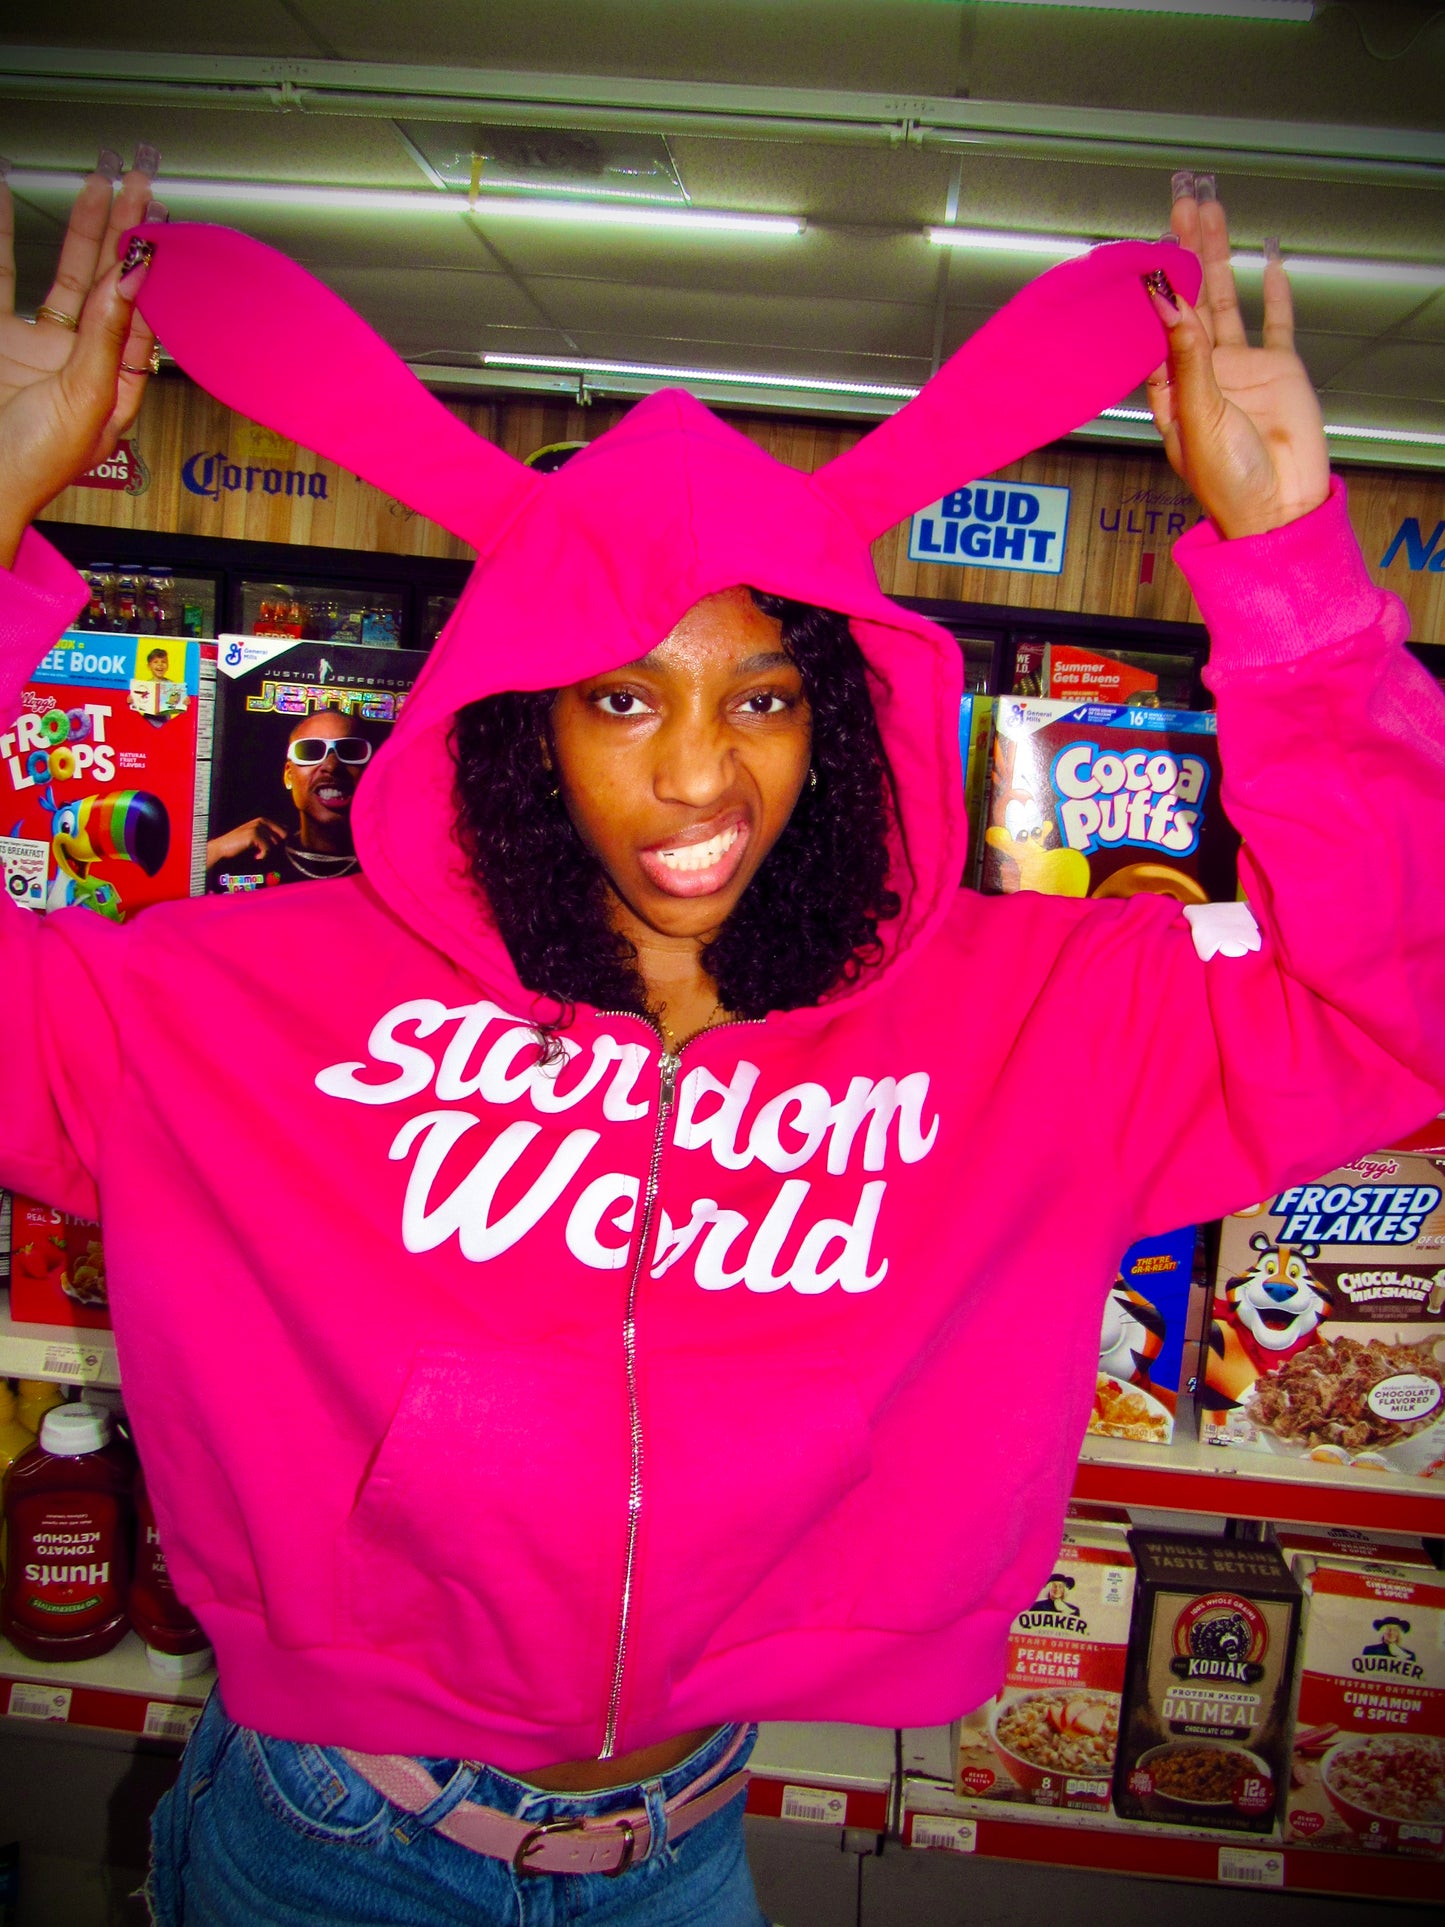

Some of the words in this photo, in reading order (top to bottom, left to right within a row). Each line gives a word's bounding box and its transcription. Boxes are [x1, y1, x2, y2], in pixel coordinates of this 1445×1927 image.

[181, 451, 328, 502] Corona
[941, 487, 1040, 525] BUD
[918, 519, 1056, 563] LIGHT
[243, 647, 268, 656] General
[1016, 653, 1031, 664] WE
[69, 651, 127, 674] BOOK
[1054, 661, 1105, 673] Summer
[264, 670, 315, 679] JUSTIN
[1053, 672, 1080, 684] Gets
[1082, 672, 1120, 685] Bueno
[1026, 709, 1053, 719] General
[1026, 716, 1041, 724] Mills
[8, 744, 115, 791] LOOPS
[1055, 746, 1205, 803] Cocoa
[219, 873, 264, 886] Cinnamon
[387, 1109, 889, 1295] World
[1274, 1187, 1440, 1214] FROSTED
[26, 1212, 47, 1223] REAL
[1281, 1214, 1422, 1242] FLAKES
[1336, 1271, 1434, 1294] CHOCOLATE
[1349, 1286, 1428, 1303] MILKSHAKE
[1374, 1388, 1436, 1399] CHOCOLATE
[1378, 1396, 1430, 1406] FLAVORED
[1390, 1404, 1416, 1413] MILK
[33, 1531, 101, 1544] KETCHUP
[37, 1544, 96, 1556] TOMATO
[1150, 1555, 1208, 1570] TASTE
[1213, 1560, 1281, 1577] BETTER
[1384, 1590, 1409, 1600] SPICE
[1190, 1602, 1206, 1617] 100%
[1205, 1597, 1233, 1606] WHOLE
[1233, 1600, 1257, 1621] GRAINS
[1018, 1613, 1088, 1634] QUAKER
[1051, 1640, 1099, 1652] OATMEAL
[1017, 1647, 1082, 1666] PEACHES
[1015, 1661, 1026, 1673] &
[1029, 1662, 1079, 1679] CREAM
[1188, 1657, 1248, 1681] KODIAK
[1351, 1657, 1424, 1679] QUAKER
[1172, 1688, 1214, 1698] PROTEIN
[1218, 1693, 1255, 1702] PACKED
[1334, 1678, 1382, 1691] INSTANT
[1385, 1685, 1436, 1698] OATMEAL
[1343, 1691, 1423, 1712] CINNAMON
[1161, 1698, 1259, 1726] OATMEAL
[1353, 1707, 1364, 1718] &
[1367, 1708, 1409, 1724] SPICE
[1184, 1725, 1219, 1735] CHOCOLATE
[1220, 1728, 1235, 1736] CHIP
[964, 1777, 991, 1785] HEALTHY
[1041, 1777, 1052, 1789] 8
[1369, 1821, 1380, 1833] 8
